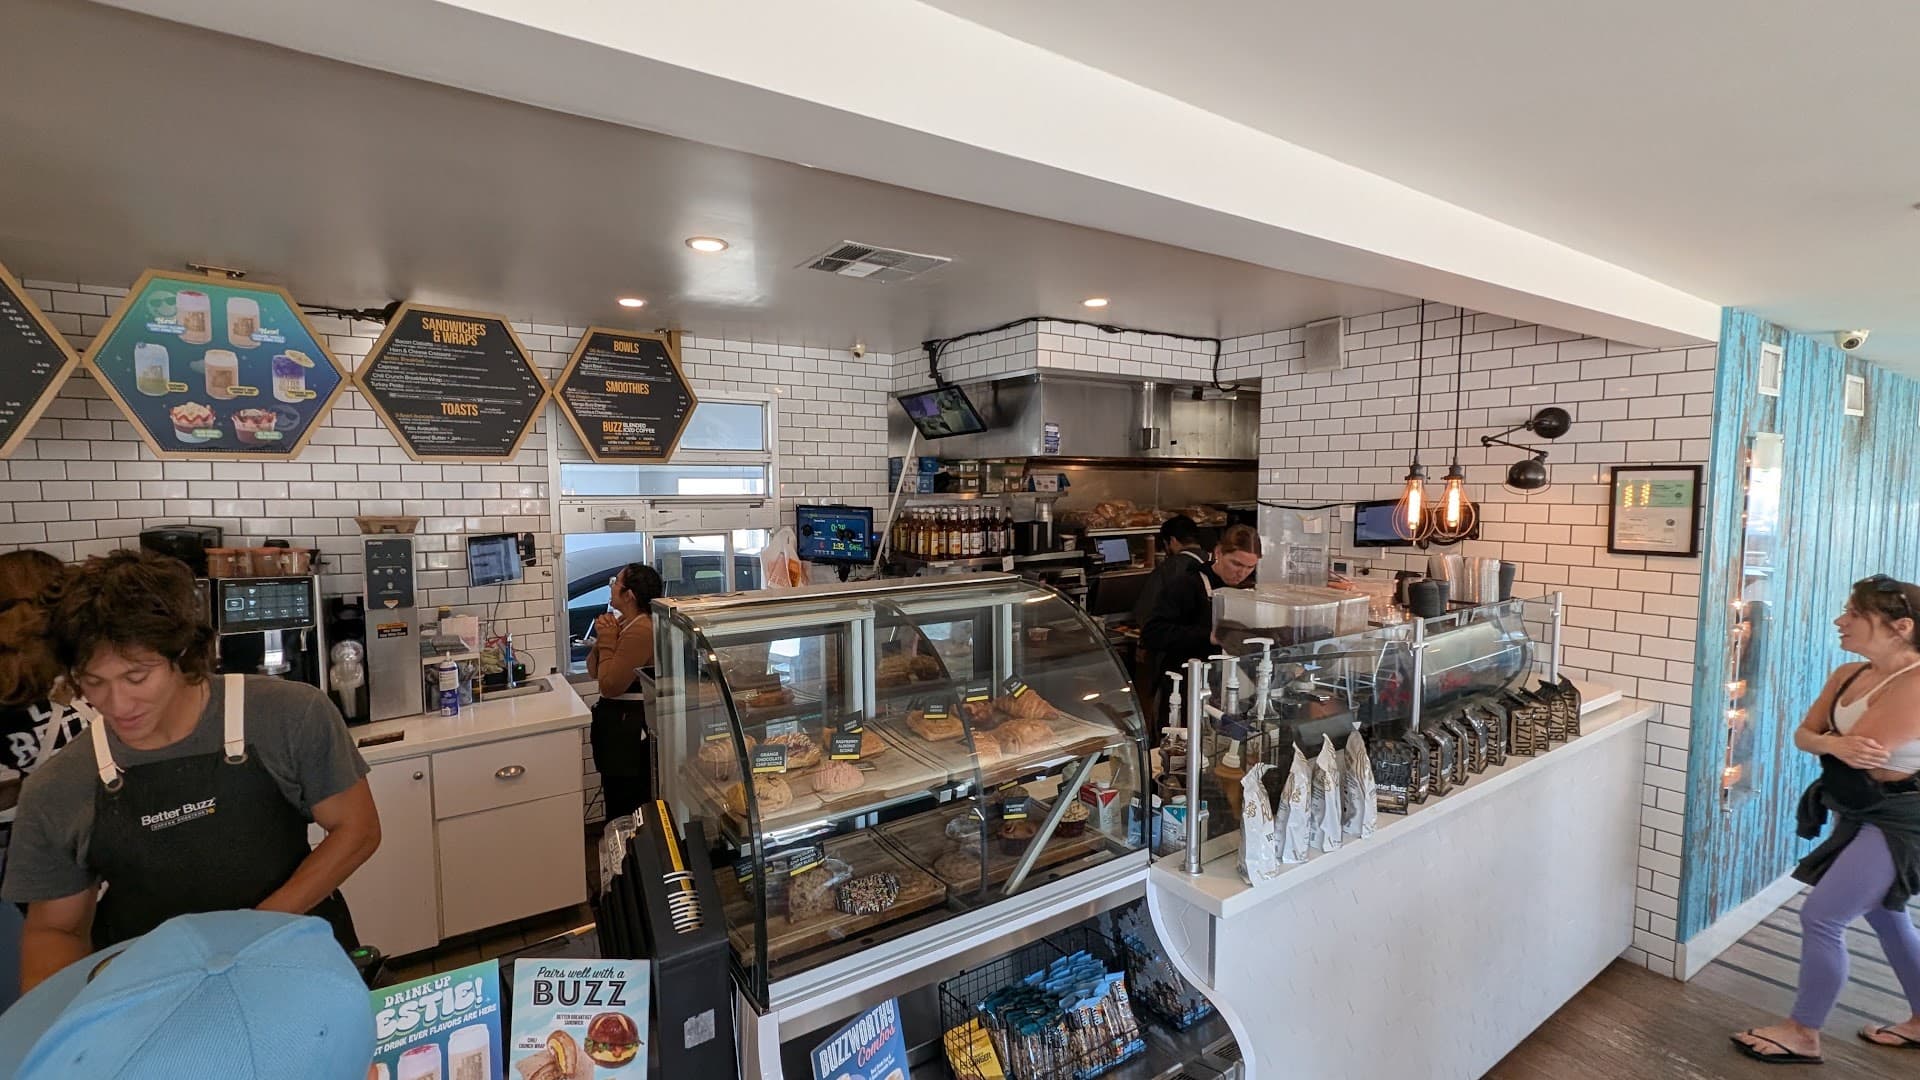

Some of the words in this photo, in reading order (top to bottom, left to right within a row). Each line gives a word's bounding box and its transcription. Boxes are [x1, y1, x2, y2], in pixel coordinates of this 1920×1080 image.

[422, 317, 487, 337] SANDWICHES
[433, 330, 441, 343] &
[442, 331, 478, 346] WRAPS
[613, 340, 640, 354] BOWLS
[605, 380, 650, 395] SMOOTHIES
[441, 402, 478, 417] TOASTS
[602, 421, 623, 433] BUZZ
[141, 808, 181, 827] Better
[182, 798, 216, 814] Buzz
[537, 966, 566, 979] Pairs
[567, 966, 591, 979] well
[592, 966, 615, 979] with
[616, 970, 625, 979] a
[384, 982, 433, 1008] DRINK
[434, 975, 452, 991] UP
[533, 979, 628, 1006] BUZZ
[1115, 980, 1129, 1002] KIND
[376, 976, 483, 1041] ESTIE!
[1079, 1007, 1090, 1027] KIND
[1091, 1006, 1104, 1026] KIND
[384, 1037, 408, 1053] DRINK
[408, 1028, 428, 1043] EVER
[430, 1016, 462, 1036] FLAVORS
[463, 1011, 478, 1022] ARE
[478, 1003, 497, 1017] HERE
[819, 999, 895, 1079] BUZZWORTHY
[857, 1023, 896, 1067] Combos
